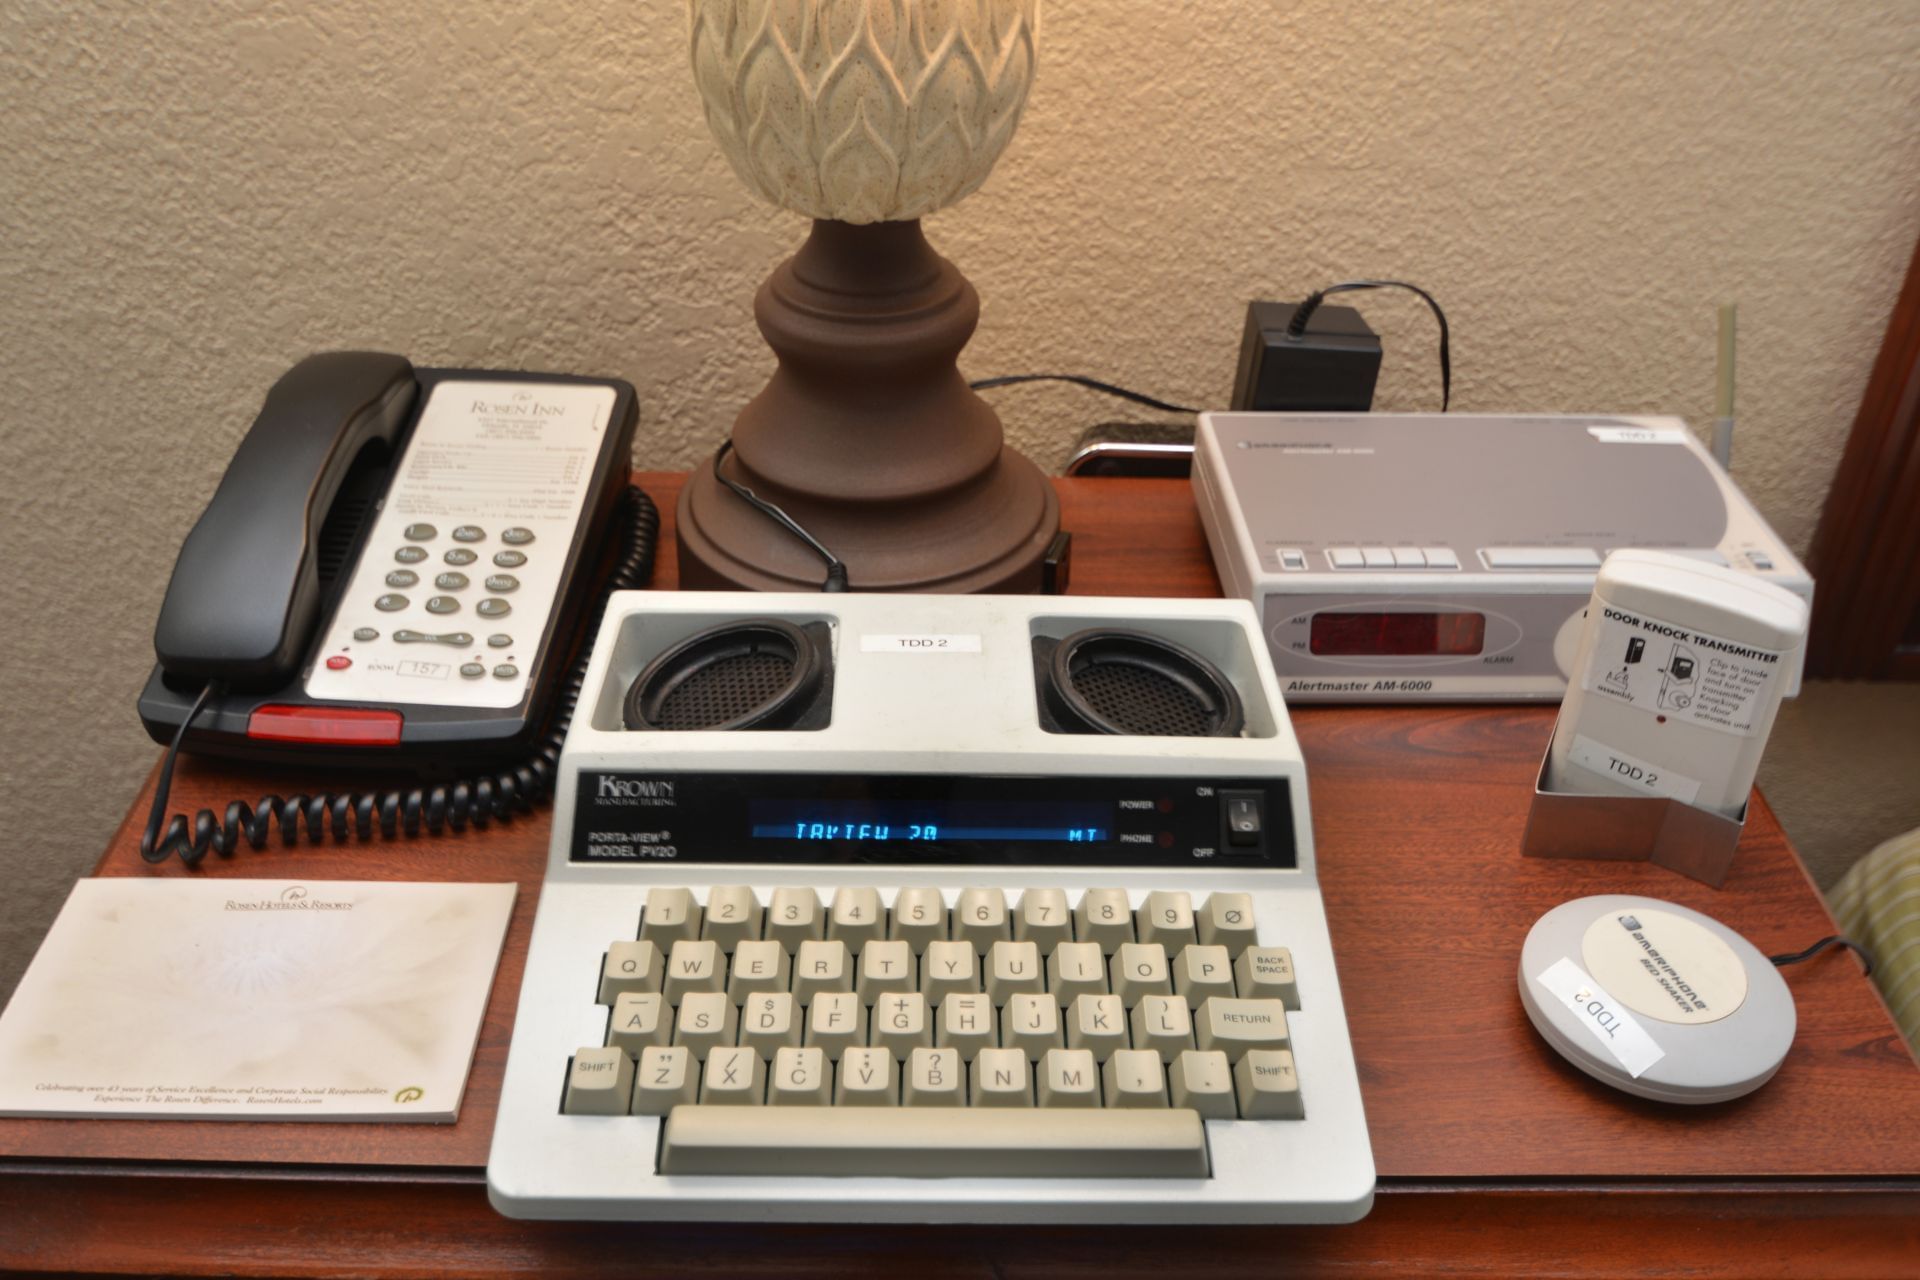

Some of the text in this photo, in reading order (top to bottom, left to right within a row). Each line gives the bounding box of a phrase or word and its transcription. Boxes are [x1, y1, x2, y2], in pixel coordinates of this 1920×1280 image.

[532, 402, 566, 416] INN
[1604, 608, 1779, 664] DOOR KNOCK TRANSMITTER
[898, 639, 949, 648] TDD 2
[1483, 656, 1515, 664] ALARM
[1710, 658, 1728, 670] Clip
[1742, 667, 1768, 679] inside
[1288, 680, 1433, 692] Alertmaster AM-6000
[1705, 677, 1722, 687] and
[1740, 676, 1761, 686] door
[1597, 684, 1635, 702] assembly
[1702, 685, 1746, 702] transmitter
[1710, 706, 1731, 716] door
[1694, 712, 1731, 726] activates
[1608, 757, 1659, 787] TDD 2
[1119, 800, 1155, 810] POWER
[1120, 834, 1154, 844] PHONE
[588, 844, 678, 858] MODEL PV20
[1192, 848, 1215, 858] OFF
[663, 907, 671, 920] 1
[721, 904, 735, 919] 2
[785, 905, 798, 920] 3
[849, 906, 862, 920] 4
[912, 905, 925, 920] 5
[976, 906, 990, 921] 6
[1039, 907, 1051, 921] 7
[1101, 905, 1114, 919] 8
[1165, 909, 1177, 924] 9
[621, 959, 637, 974] Q
[683, 960, 703, 974] W
[751, 960, 763, 974] E
[815, 960, 829, 974] R
[880, 960, 894, 974] T
[945, 960, 957, 974] Y
[1257, 956, 1285, 965] BACK
[1640, 958, 1660, 976] BED
[1009, 961, 1023, 975] U
[1137, 963, 1153, 977] O
[1202, 964, 1216, 977] P
[1256, 965, 1289, 975] SPACE
[1656, 977, 1694, 1013] SHAKER
[765, 999, 775, 1011] $
[1223, 1013, 1271, 1024] RETURN
[1574, 987, 1622, 1038] TDD 2
[627, 1014, 643, 1028] A
[695, 1013, 709, 1028] S
[760, 1014, 775, 1028] D
[829, 1014, 843, 1027] F
[893, 1013, 909, 1028] G
[961, 1015, 975, 1029] H
[1029, 1015, 1041, 1028] J
[1094, 1015, 1109, 1029] K
[1161, 1016, 1174, 1031] L
[578, 1061, 614, 1072] SHIFT
[1255, 1065, 1291, 1076] SHIFT
[654, 1068, 671, 1084] Z
[722, 1069, 738, 1084] X
[790, 1070, 807, 1085] C
[859, 1069, 874, 1085] V
[928, 1070, 943, 1085] B
[996, 1070, 1011, 1085] N
[1062, 1071, 1081, 1086] M
[155, 1085, 186, 1093] Service
[188, 1086, 234, 1094] Excellence
[256, 1087, 298, 1097] Corporate
[301, 1087, 326, 1096] Social
[94, 1094, 141, 1103] Experience
[144, 1094, 162, 1103] The
[164, 1095, 191, 1103] Rosen
